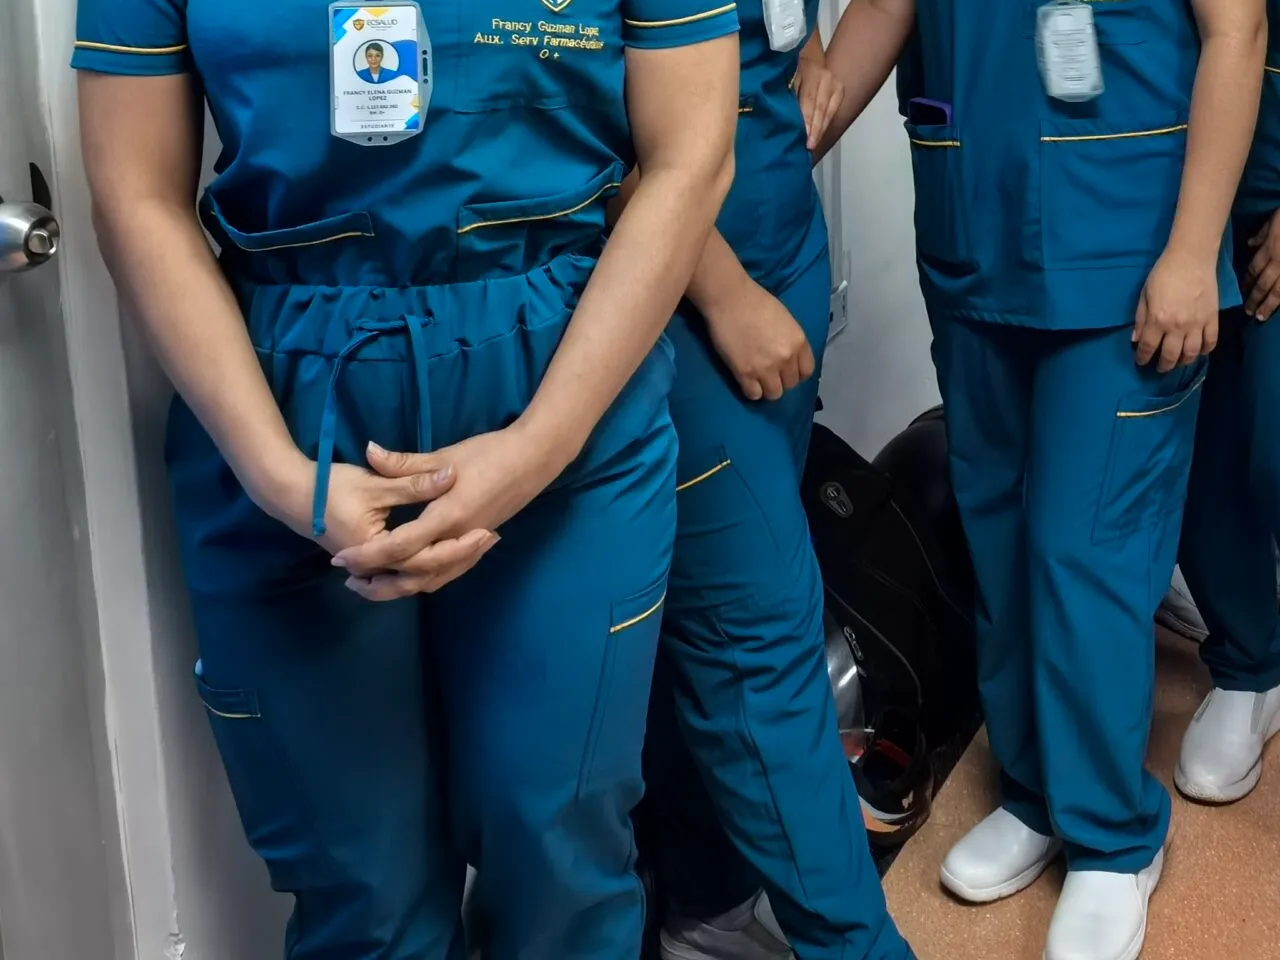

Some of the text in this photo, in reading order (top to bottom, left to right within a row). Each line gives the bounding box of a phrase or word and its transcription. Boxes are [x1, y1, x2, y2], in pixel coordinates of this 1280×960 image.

[491, 18, 532, 34] Francy
[537, 20, 575, 34] Guzman
[474, 32, 504, 45] Aux.
[511, 34, 539, 46] Serv
